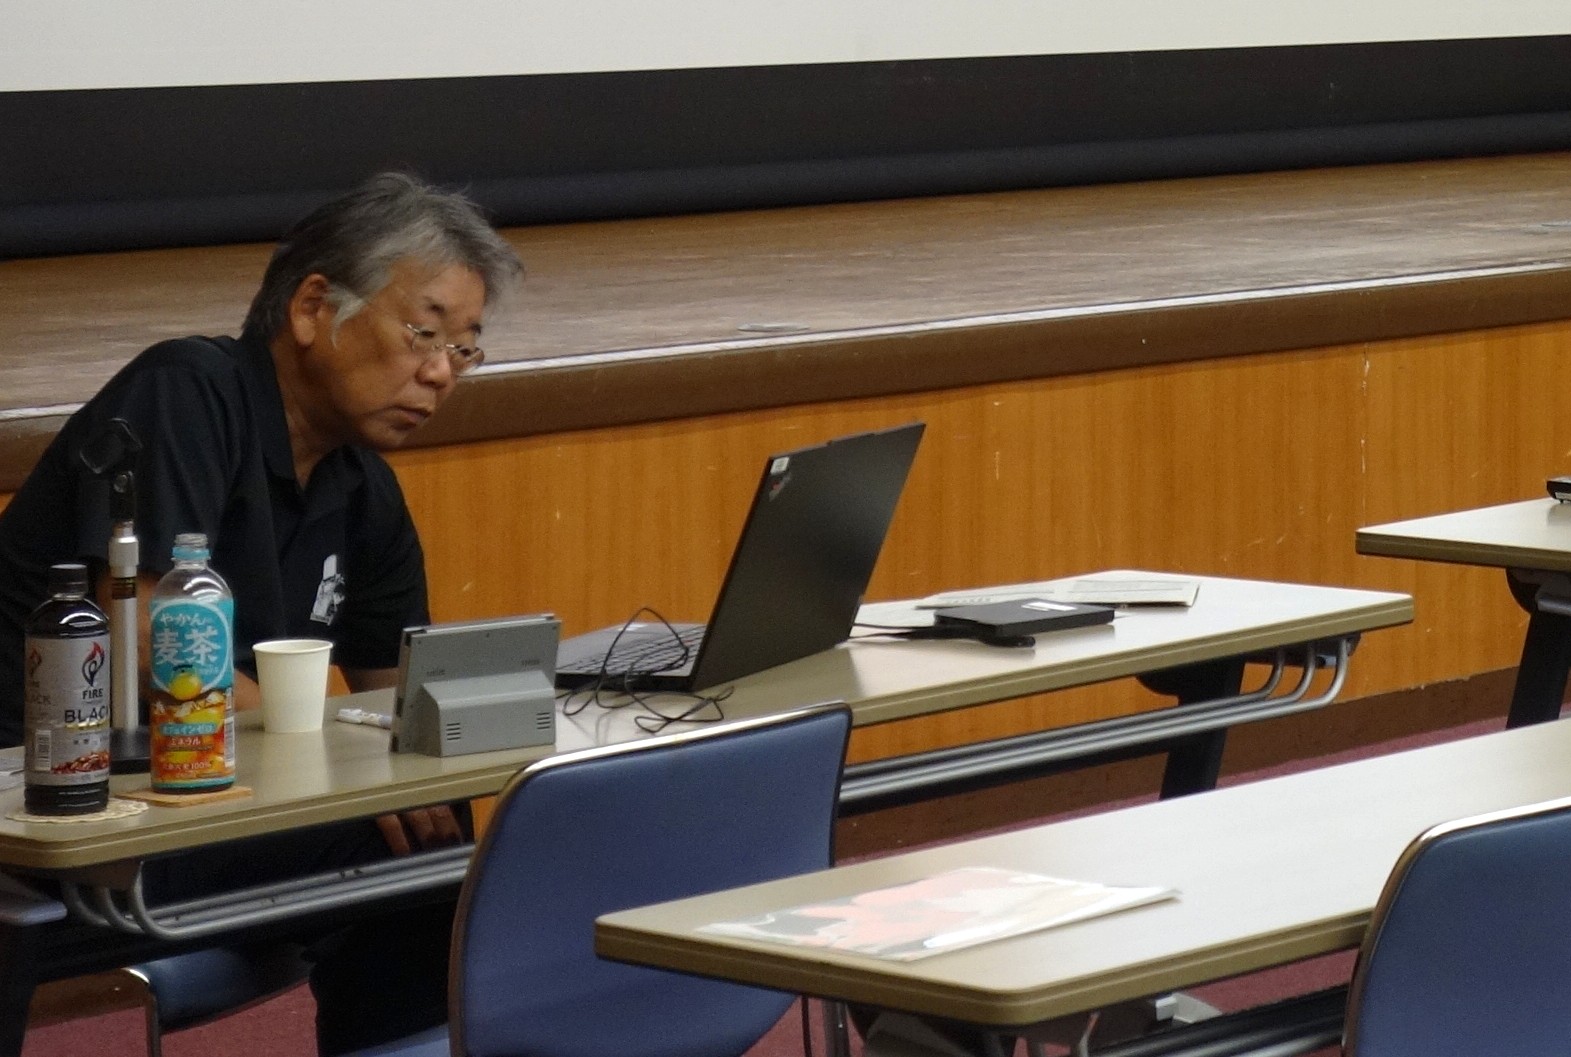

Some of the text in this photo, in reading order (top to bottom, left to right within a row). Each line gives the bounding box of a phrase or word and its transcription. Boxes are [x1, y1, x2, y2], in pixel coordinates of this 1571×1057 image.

[153, 626, 222, 665] 麦茶
[82, 688, 104, 700] FIRE
[64, 705, 109, 723] BLAC
